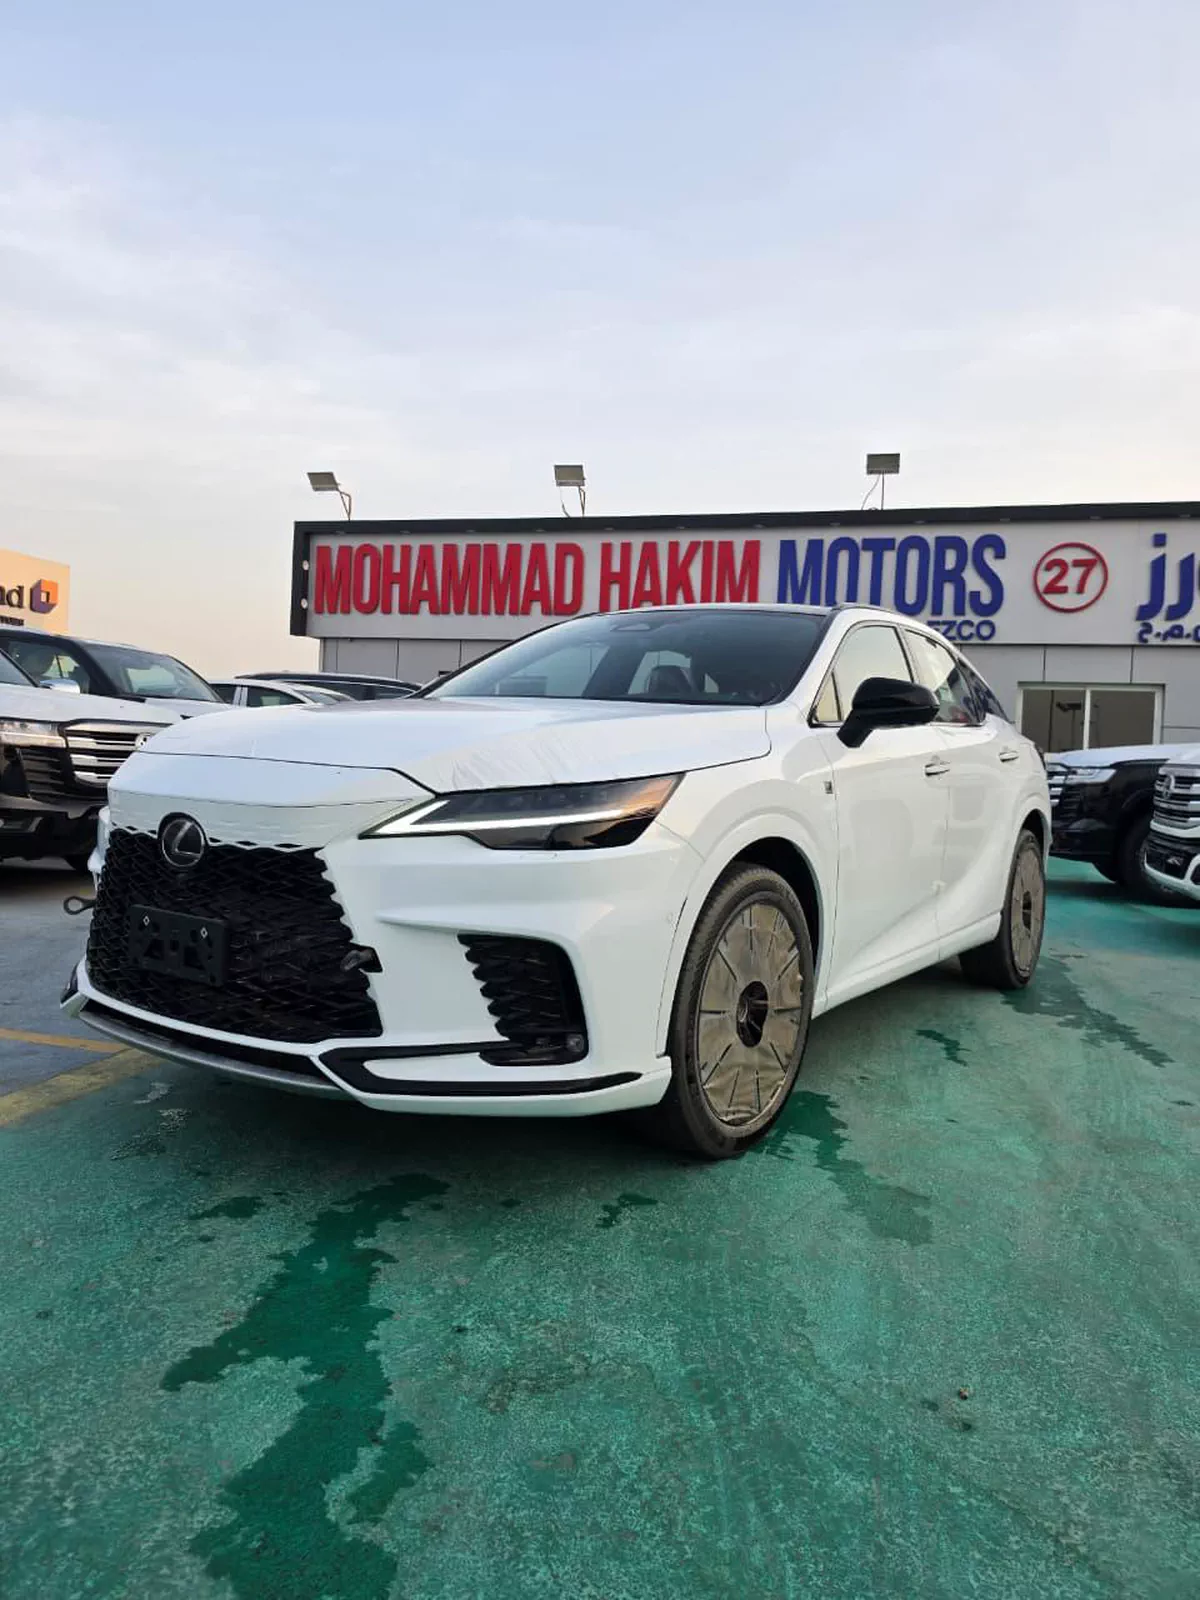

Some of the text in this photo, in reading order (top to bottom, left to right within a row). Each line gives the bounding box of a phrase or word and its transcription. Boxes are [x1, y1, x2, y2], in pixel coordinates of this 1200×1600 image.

[314, 534, 1007, 617] MOHAMMAD HAKIM MOTORS
[1043, 558, 1098, 595] 27
